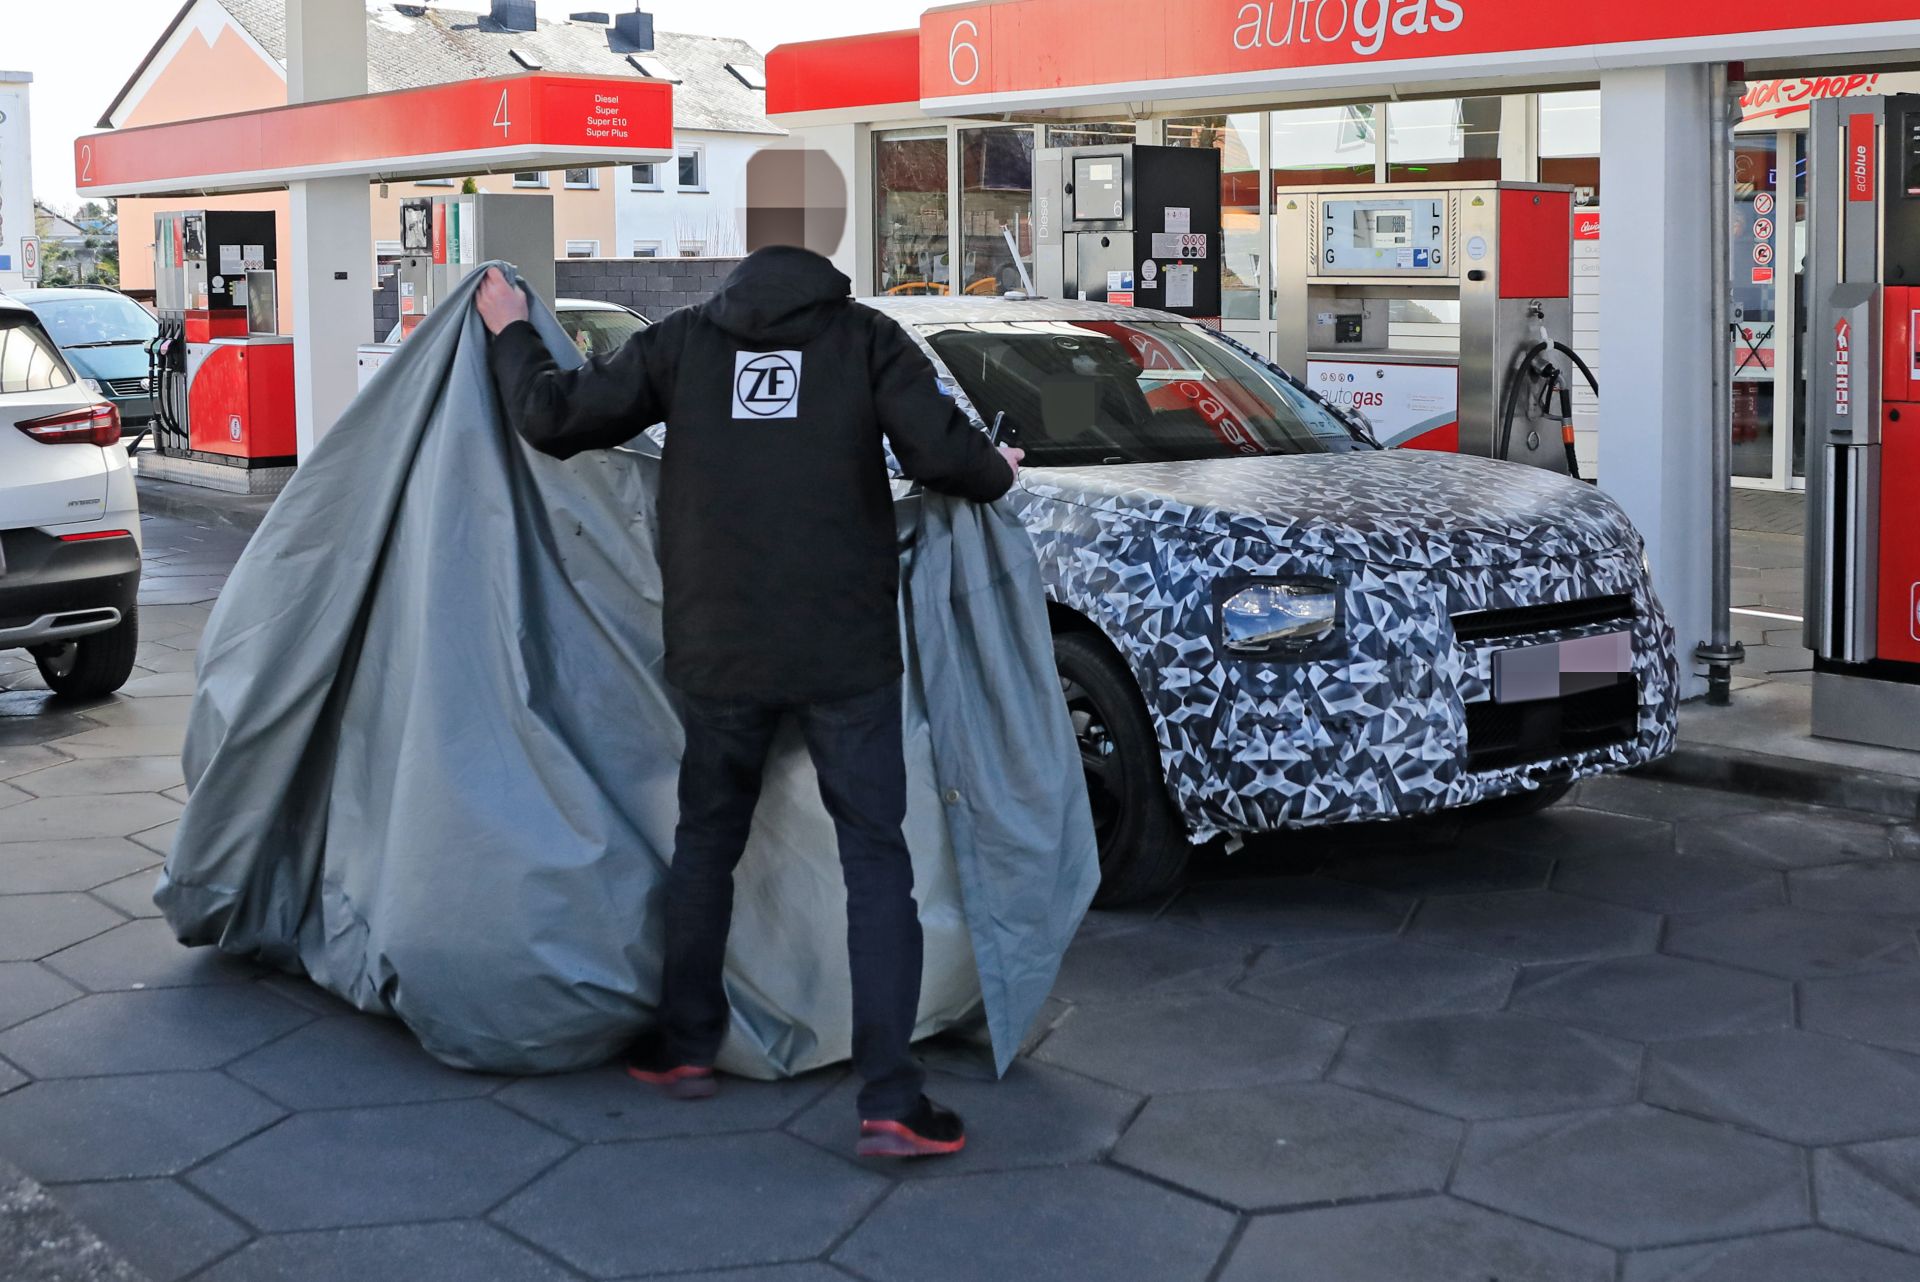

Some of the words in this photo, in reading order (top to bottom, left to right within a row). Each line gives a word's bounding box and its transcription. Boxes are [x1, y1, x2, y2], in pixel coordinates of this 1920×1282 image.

[1233, 0, 1464, 55] autogas
[949, 20, 979, 86] 6
[493, 87, 512, 138] 4
[594, 94, 619, 103] Diesel
[595, 105, 619, 115] Super
[586, 127, 610, 137] Super
[611, 129, 628, 138] Plus
[587, 116, 611, 126] Super
[612, 118, 627, 127] E10
[81, 144, 92, 182] 2
[1854, 145, 1867, 192] adblue
[1038, 197, 1049, 239] Diesel
[1112, 200, 1123, 217] 6
[742, 366, 794, 403] ZF
[1321, 386, 1384, 410] autogas
